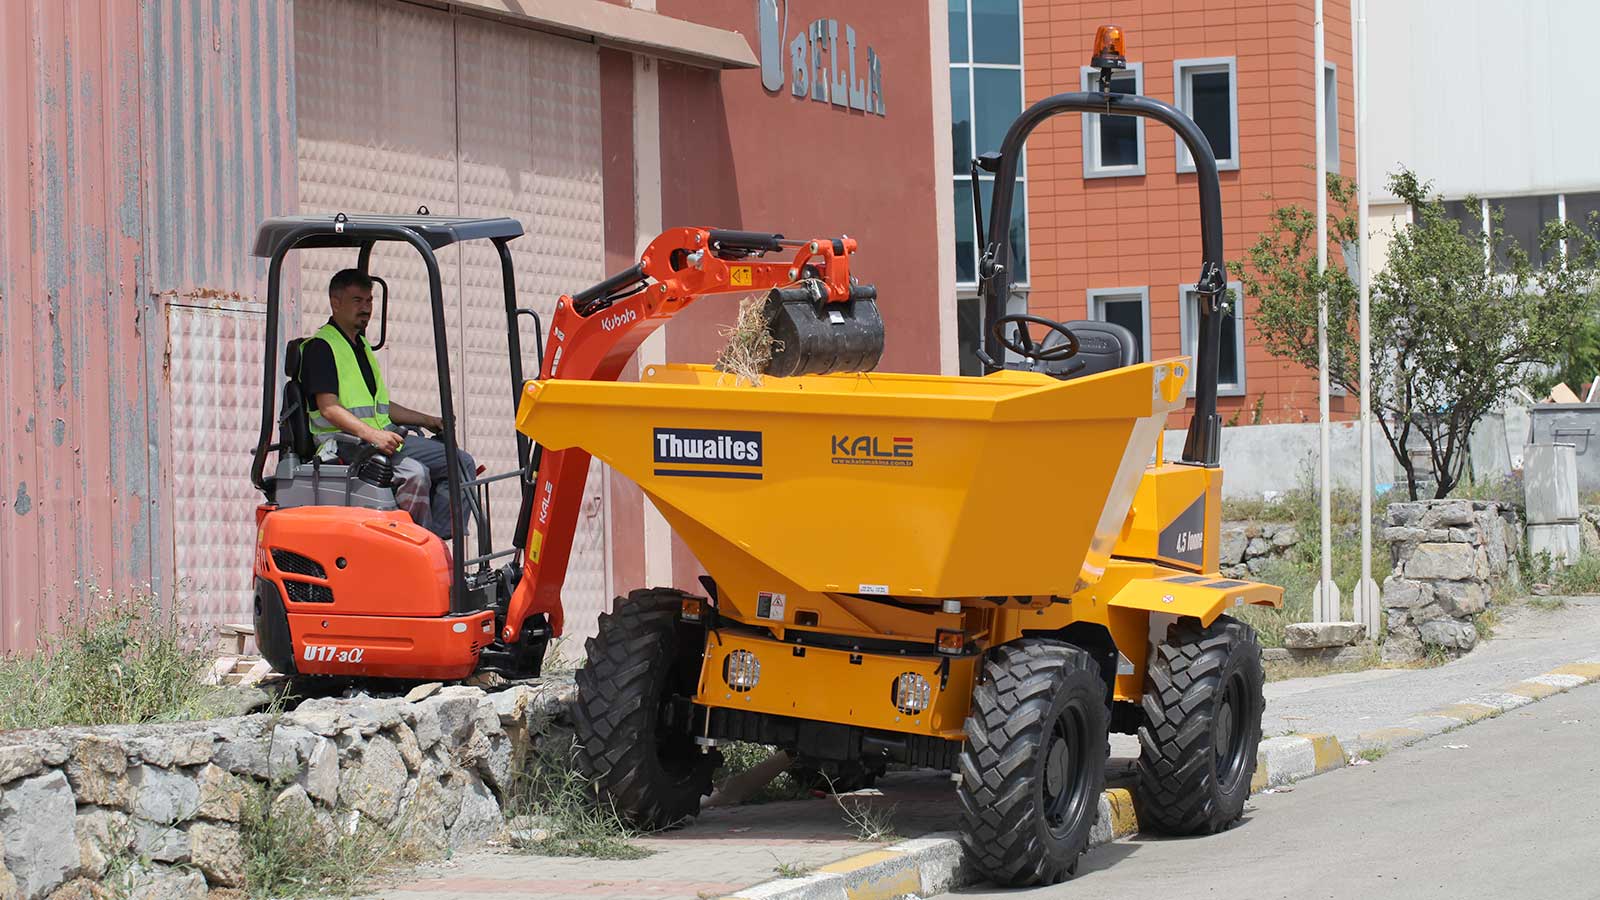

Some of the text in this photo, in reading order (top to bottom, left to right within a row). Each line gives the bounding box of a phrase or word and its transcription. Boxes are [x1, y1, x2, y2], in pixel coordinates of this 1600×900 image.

[790, 18, 885, 116] BELLA
[601, 309, 637, 331] Kubota
[656, 433, 759, 461] Thwaites
[831, 434, 914, 457] KALE
[539, 480, 553, 525] KALE
